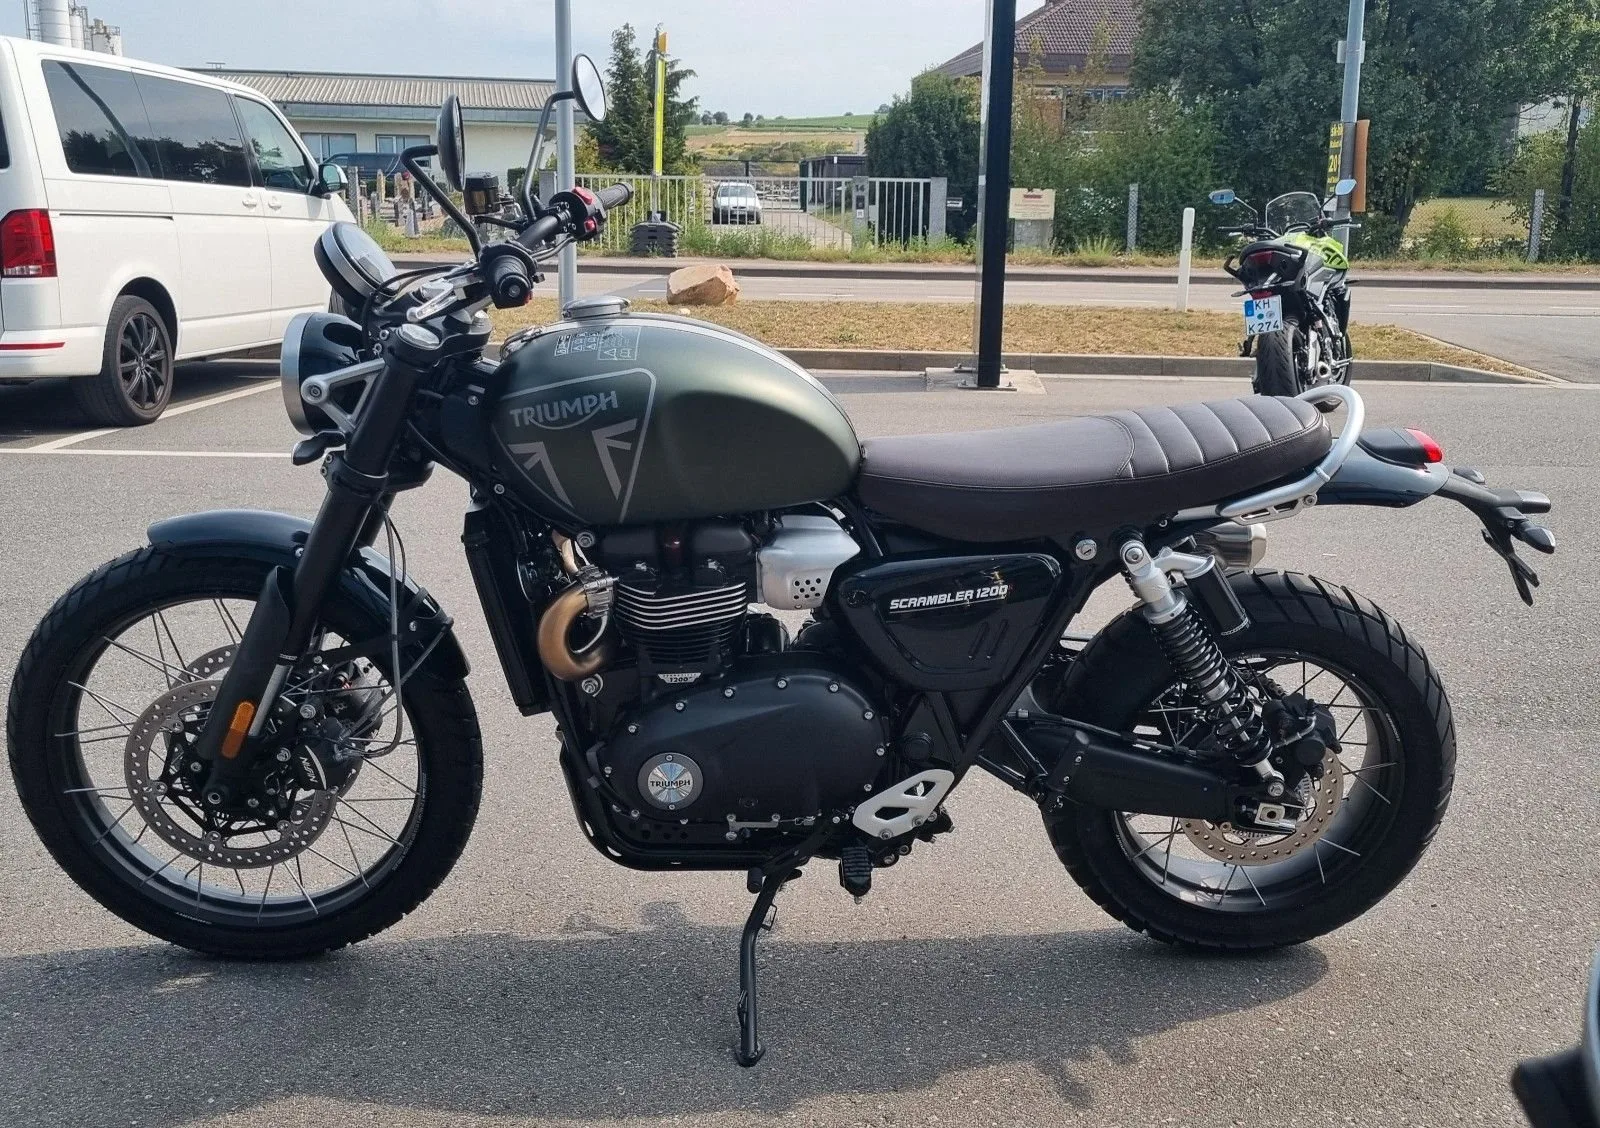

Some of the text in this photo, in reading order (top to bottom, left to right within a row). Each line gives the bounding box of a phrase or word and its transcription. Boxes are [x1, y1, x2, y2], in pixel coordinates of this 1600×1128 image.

[1255, 299, 1270, 310] KH
[509, 390, 618, 428] TRIUMPH
[890, 584, 1008, 609] SCRAMBLER 1200
[650, 779, 691, 788] TRIUMPH
